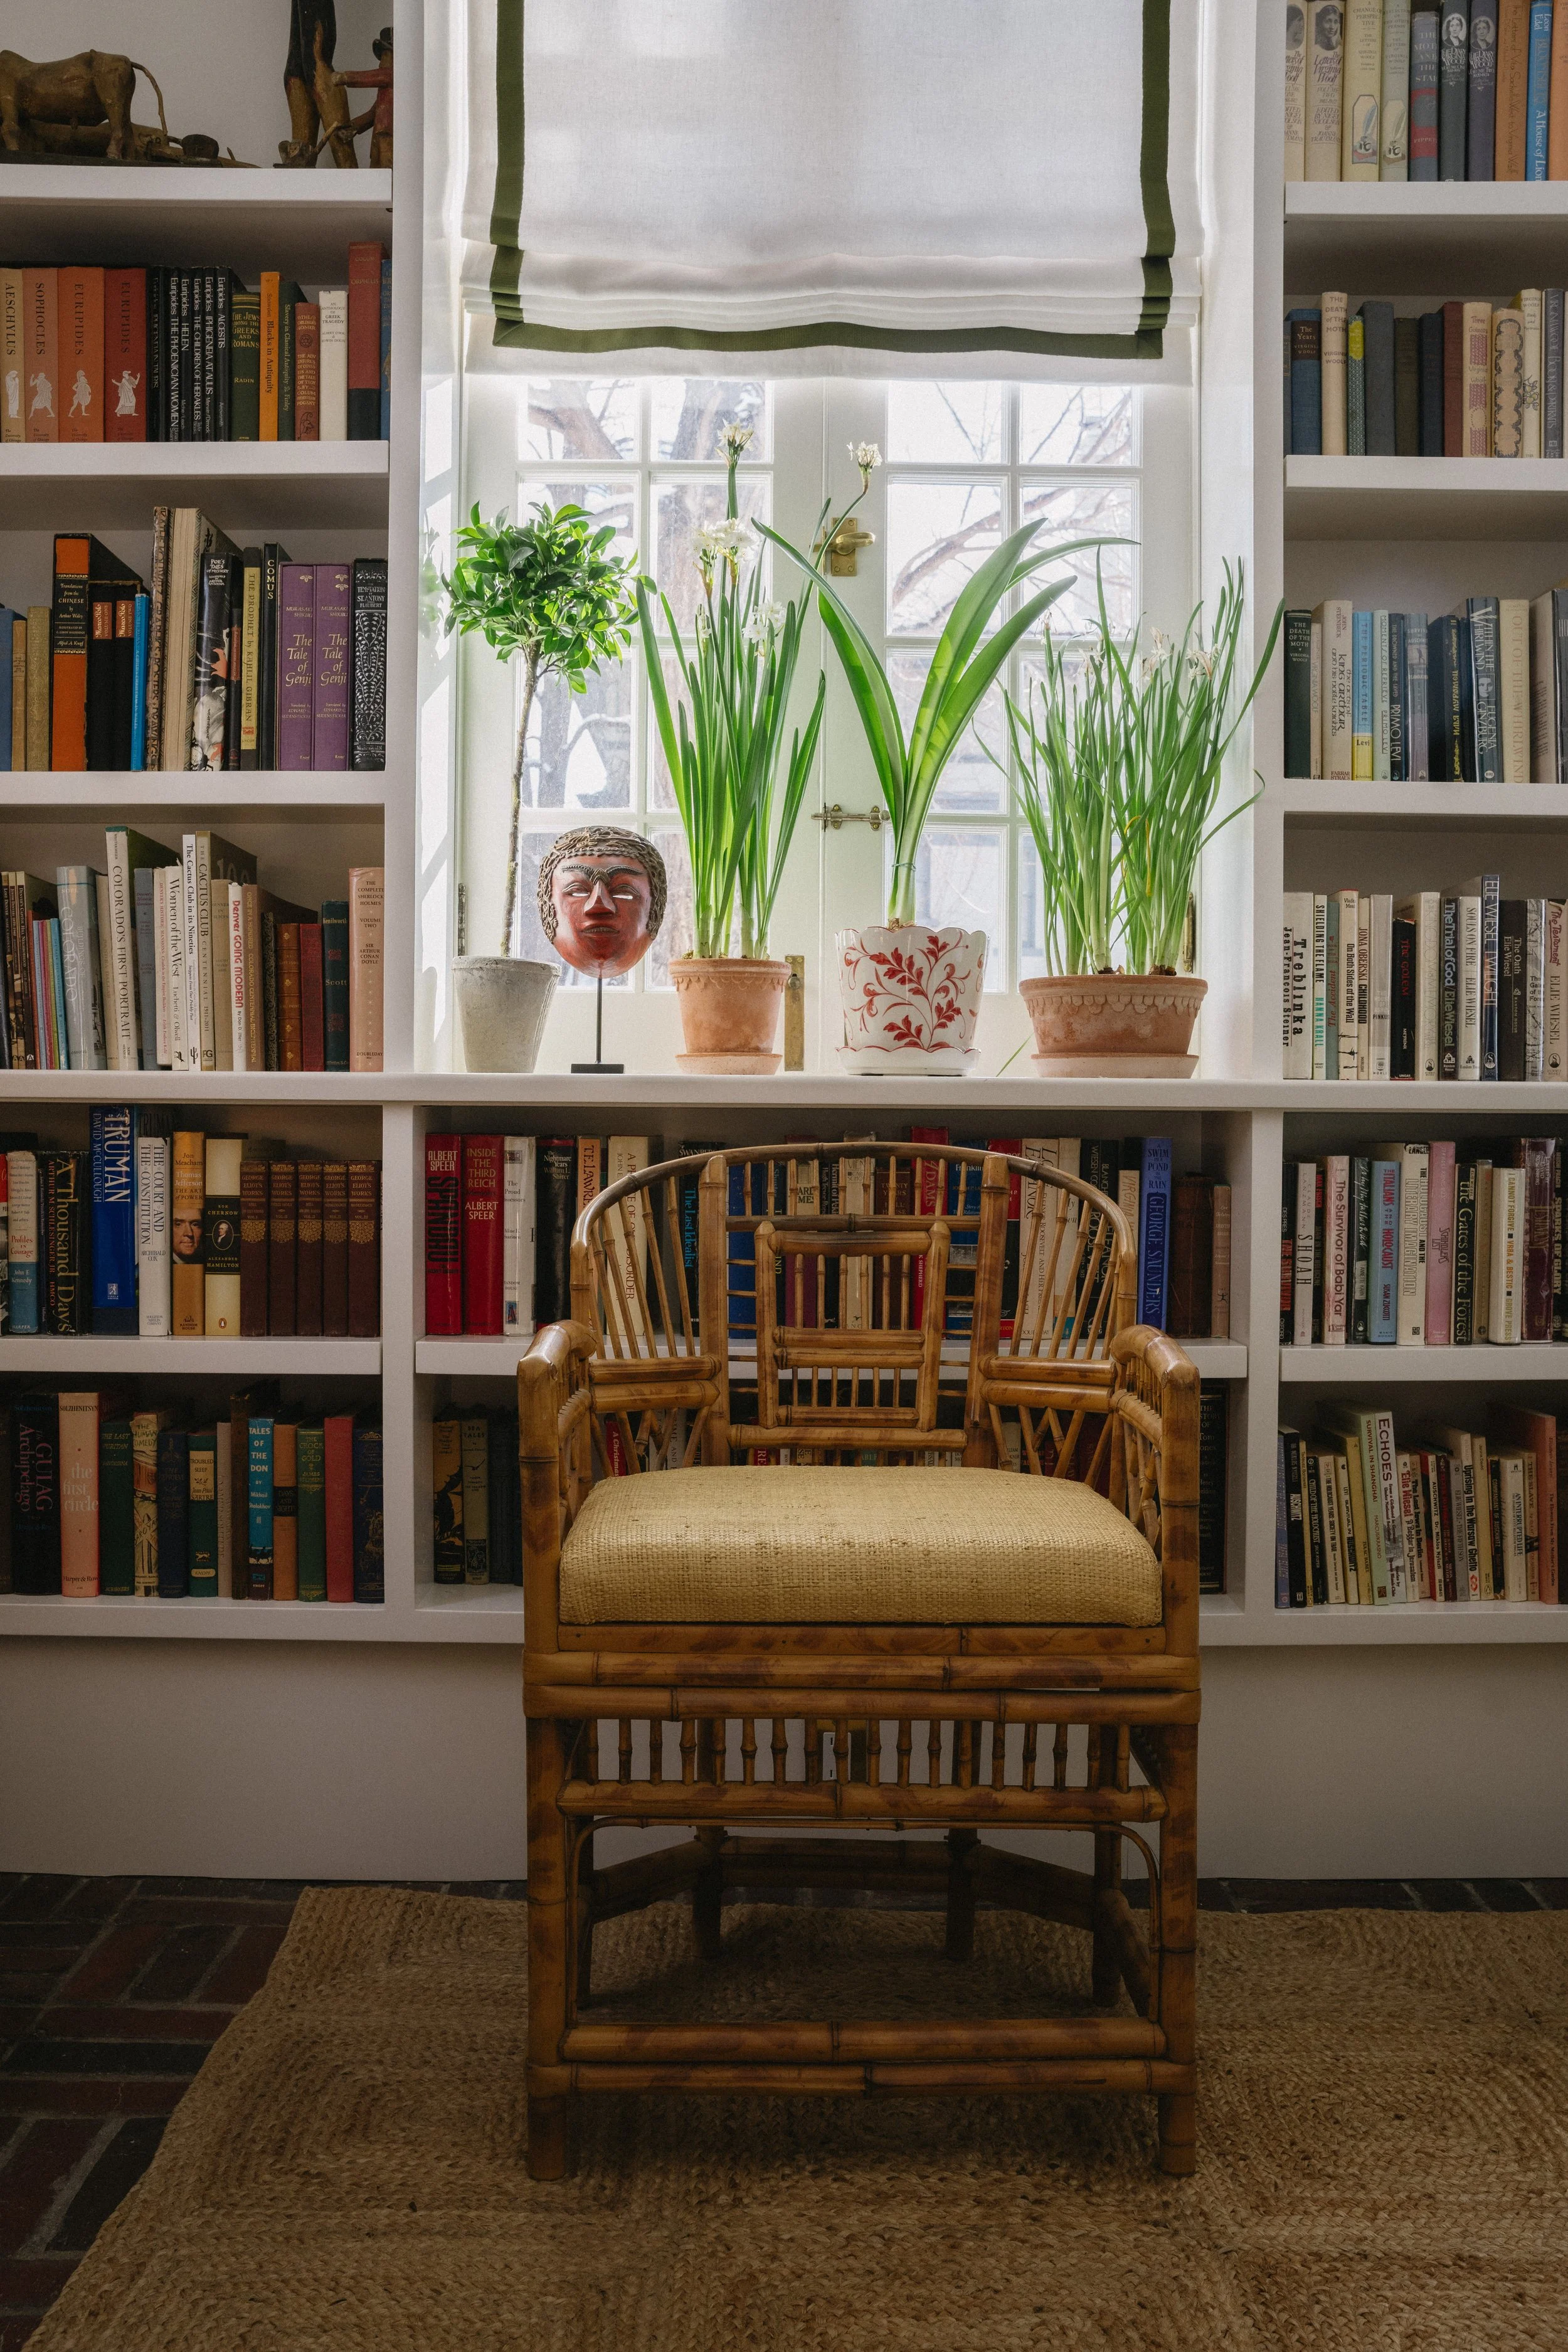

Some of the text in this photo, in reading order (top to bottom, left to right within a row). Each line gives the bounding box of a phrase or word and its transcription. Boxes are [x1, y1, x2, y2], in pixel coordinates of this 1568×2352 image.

[1534, 15, 1543, 30] Edel
[1535, 120, 1545, 147] House
[1536, 110, 1545, 119] A
[1535, 149, 1544, 158] of
[170, 278, 178, 314] Euripides
[217, 277, 225, 308] Euripides
[6, 283, 16, 354] AESCHYLUS
[36, 283, 45, 354] SOPHOCLES
[75, 284, 83, 354] EURIPIDES
[122, 282, 130, 352] EURIPIDES
[287, 648, 307, 659] Tale
[294, 634, 312, 645] The
[243, 652, 253, 683] KAHLIL
[285, 672, 312, 687] Genji
[298, 661, 308, 674] of
[1391, 704, 1401, 761] PRIMO LEVI
[1476, 701, 1487, 755] GINZBURG
[1486, 705, 1496, 750] EUGENIA
[199, 864, 208, 906] CACTUS
[169, 879, 182, 977] Women of the West
[200, 909, 208, 936] CLUB
[1316, 905, 1325, 983] SHIELDING THE FLAME
[1466, 908, 1476, 966] SOULS ON FIRE
[60, 907, 77, 1001] COLORADO
[114, 866, 130, 1041] COLORADO'S FIRST PORTRAIT
[234, 935, 242, 963] GOING
[1347, 953, 1355, 968] Both
[235, 967, 243, 1008] MODERN
[1293, 939, 1306, 1035] Treblinka
[1359, 927, 1367, 1024] JONA OBERSKI CHILDHOOD
[1315, 997, 1325, 1048] HANNA KRALL
[1346, 1008, 1354, 1022] Wall
[1550, 976, 1560, 1044] ELIE WIESEL
[93, 1113, 103, 1202] DAVID McCULLOUGH
[105, 1115, 130, 1202] TRUMAN
[428, 1151, 458, 1161] ALBERT
[430, 1161, 455, 1171] SPEER
[467, 1149, 497, 1157] INSIDE
[469, 1169, 495, 1177] THIRD
[473, 1159, 492, 1167] THE
[141, 1145, 151, 1244] THE CONSTITUTION
[154, 1145, 164, 1232] THE COURT AND
[468, 1179, 495, 1187] REICH
[426, 1174, 459, 1263] SPANDAU
[685, 1188, 696, 1268] The Last Idealist
[1403, 1179, 1419, 1296] LITERARY IMAGINATION
[53, 1159, 80, 1332] A Thousand Days
[1145, 1196, 1164, 1315] GEORGE SAUNDERS
[1295, 1234, 1313, 1286] SHOAH
[1333, 1180, 1345, 1316] The Survivor of Babi Yar
[1431, 1239, 1440, 1251] LIST
[1439, 1227, 1449, 1264] SCHINDLER'S
[1456, 1182, 1473, 1342] the Gates of the Forest
[15, 1424, 33, 1511] Archipelago
[1379, 1418, 1392, 1481] ECHOES
[33, 1443, 53, 1510] GULAG
[1463, 1465, 1475, 1494] Uprising
[1290, 1494, 1302, 1520] AUSCHWITZ
[1466, 1505, 1475, 1517] the
[1468, 1518, 1476, 1545] Warsaw
[1468, 1548, 1478, 1571] Ghetto
